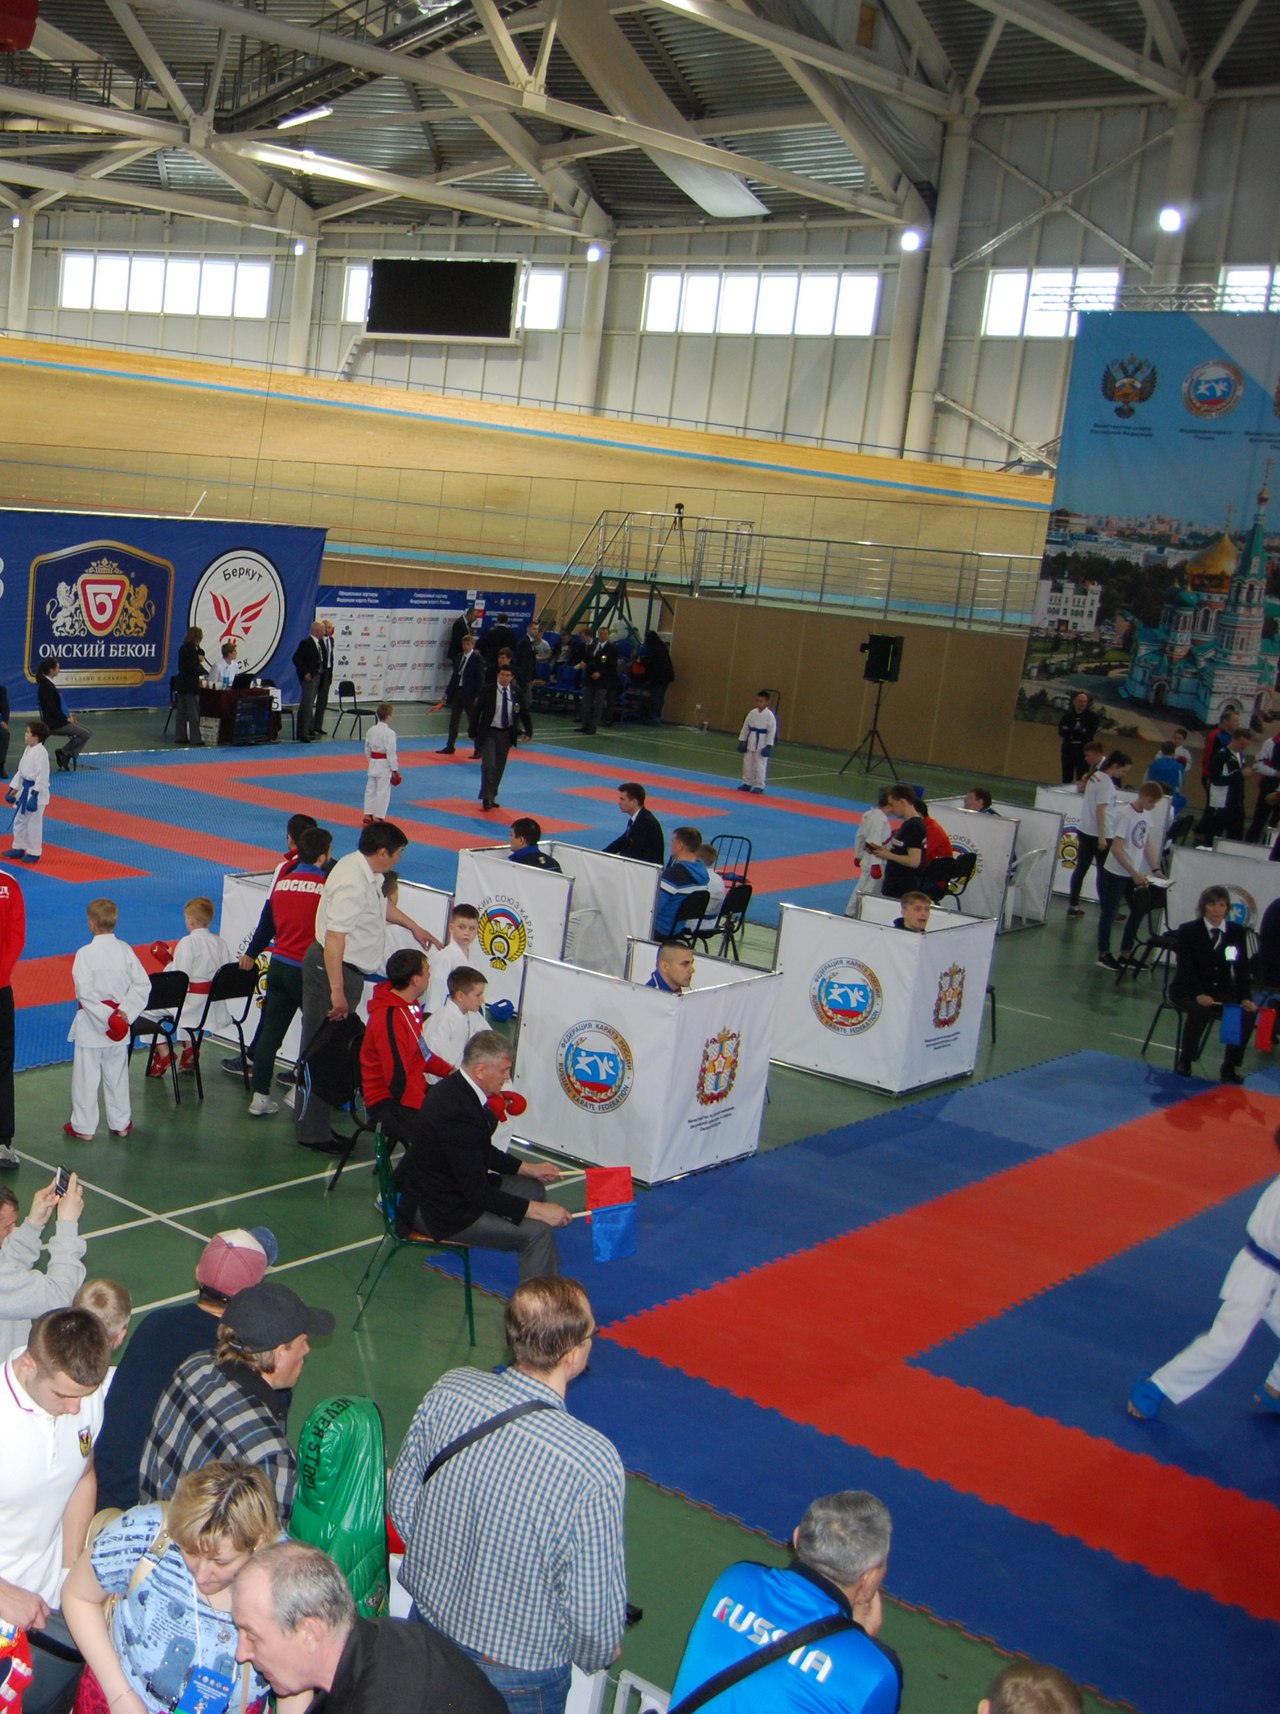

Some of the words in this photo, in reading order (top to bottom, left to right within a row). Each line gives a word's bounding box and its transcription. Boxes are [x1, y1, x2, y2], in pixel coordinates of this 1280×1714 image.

[222, 566, 263, 582] Беркут
[39, 640, 105, 658] ОМСКИЙ
[109, 643, 157, 658] БЕКОН
[495, 894, 519, 909] СОЮЗ
[560, 1022, 593, 1049] ФЕДЕРАЦИЯ
[595, 1023, 619, 1040] КАРАТЭ
[572, 1094, 596, 1112] KARATE
[598, 1084, 630, 1112] FEDERATION
